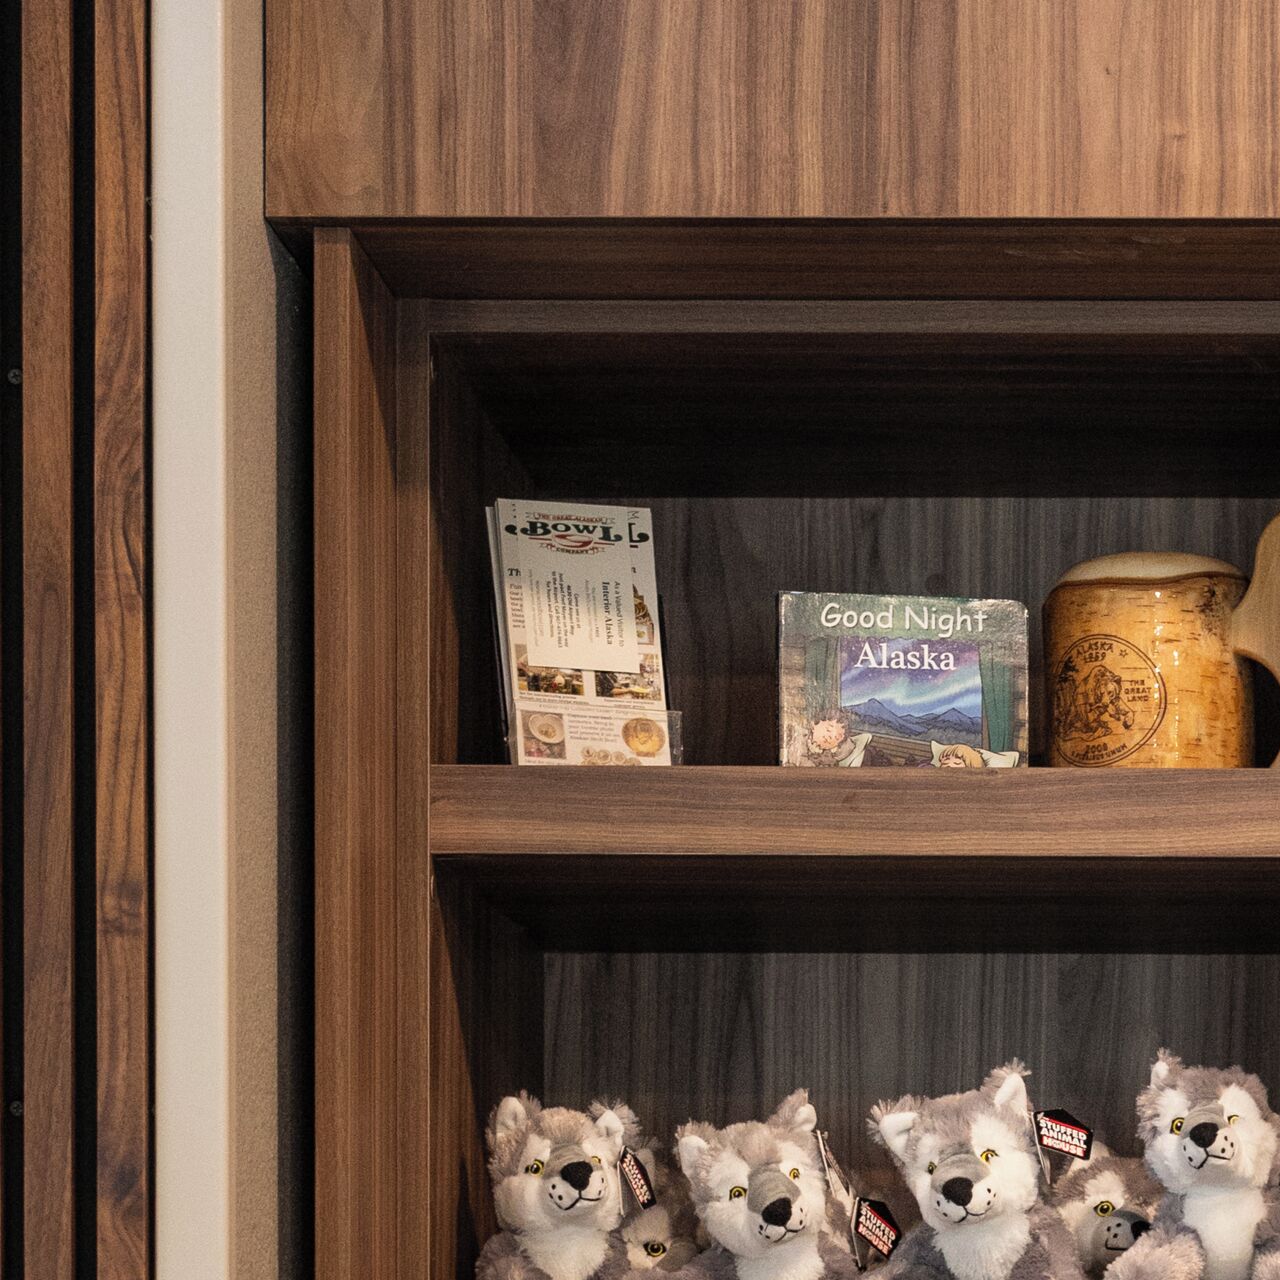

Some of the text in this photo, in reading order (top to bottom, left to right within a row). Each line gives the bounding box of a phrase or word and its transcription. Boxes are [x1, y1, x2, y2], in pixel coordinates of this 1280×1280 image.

[520, 520, 623, 542] BOWL
[602, 581, 614, 645] Interior Alaska
[820, 602, 988, 638] Good Night
[854, 642, 957, 671] Alaska
[1076, 641, 1114, 656] ALASKA
[1039, 1119, 1087, 1141] STUFFED
[1040, 1127, 1087, 1149] ANIMAL
[1042, 1135, 1085, 1157] HOUSE
[859, 1215, 893, 1248] ANIMAL
[860, 1207, 896, 1241] STUFFED
[858, 1223, 889, 1256] HOUSE
